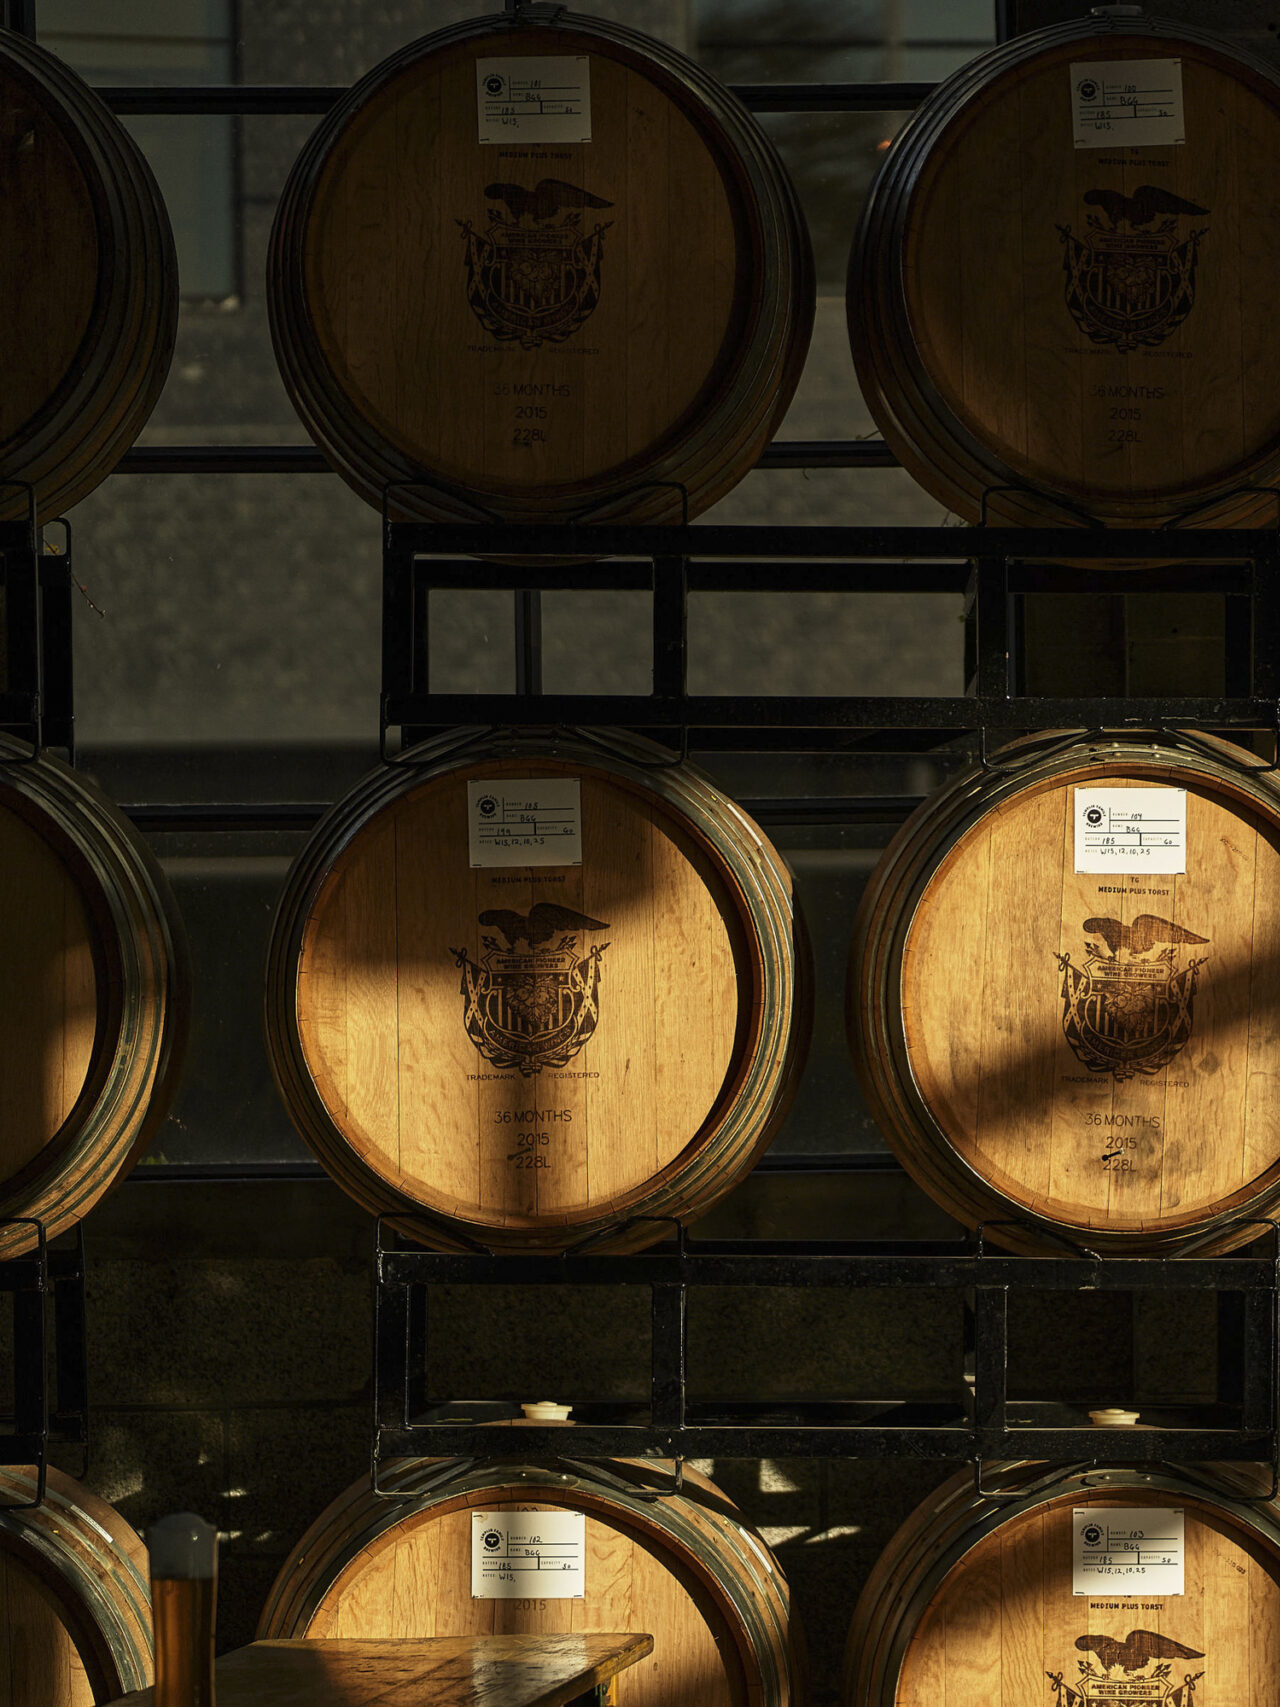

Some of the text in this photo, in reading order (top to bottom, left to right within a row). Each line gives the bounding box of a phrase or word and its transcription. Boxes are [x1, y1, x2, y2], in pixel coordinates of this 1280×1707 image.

[513, 384, 570, 397] MONTHS
[1108, 385, 1165, 399] MONTHS
[515, 406, 548, 419] 2015
[1109, 407, 1141, 420] 2015
[513, 428, 546, 442] 228L
[1107, 430, 1143, 442] 228L
[1098, 886, 1127, 894] MEDIUM
[1148, 888, 1169, 896] TOAST
[1140, 1080, 1189, 1088] REGISTERED
[494, 1109, 572, 1124] 36 MONTHS
[1085, 1112, 1160, 1129] 36 MONTHS
[517, 1132, 550, 1146] 2015
[1105, 1136, 1137, 1149] 2015
[516, 1156, 551, 1169] 228L
[1103, 1159, 1137, 1172] 228L
[514, 1600, 546, 1611] 2015
[1090, 1602, 1120, 1610] MEDIUM
